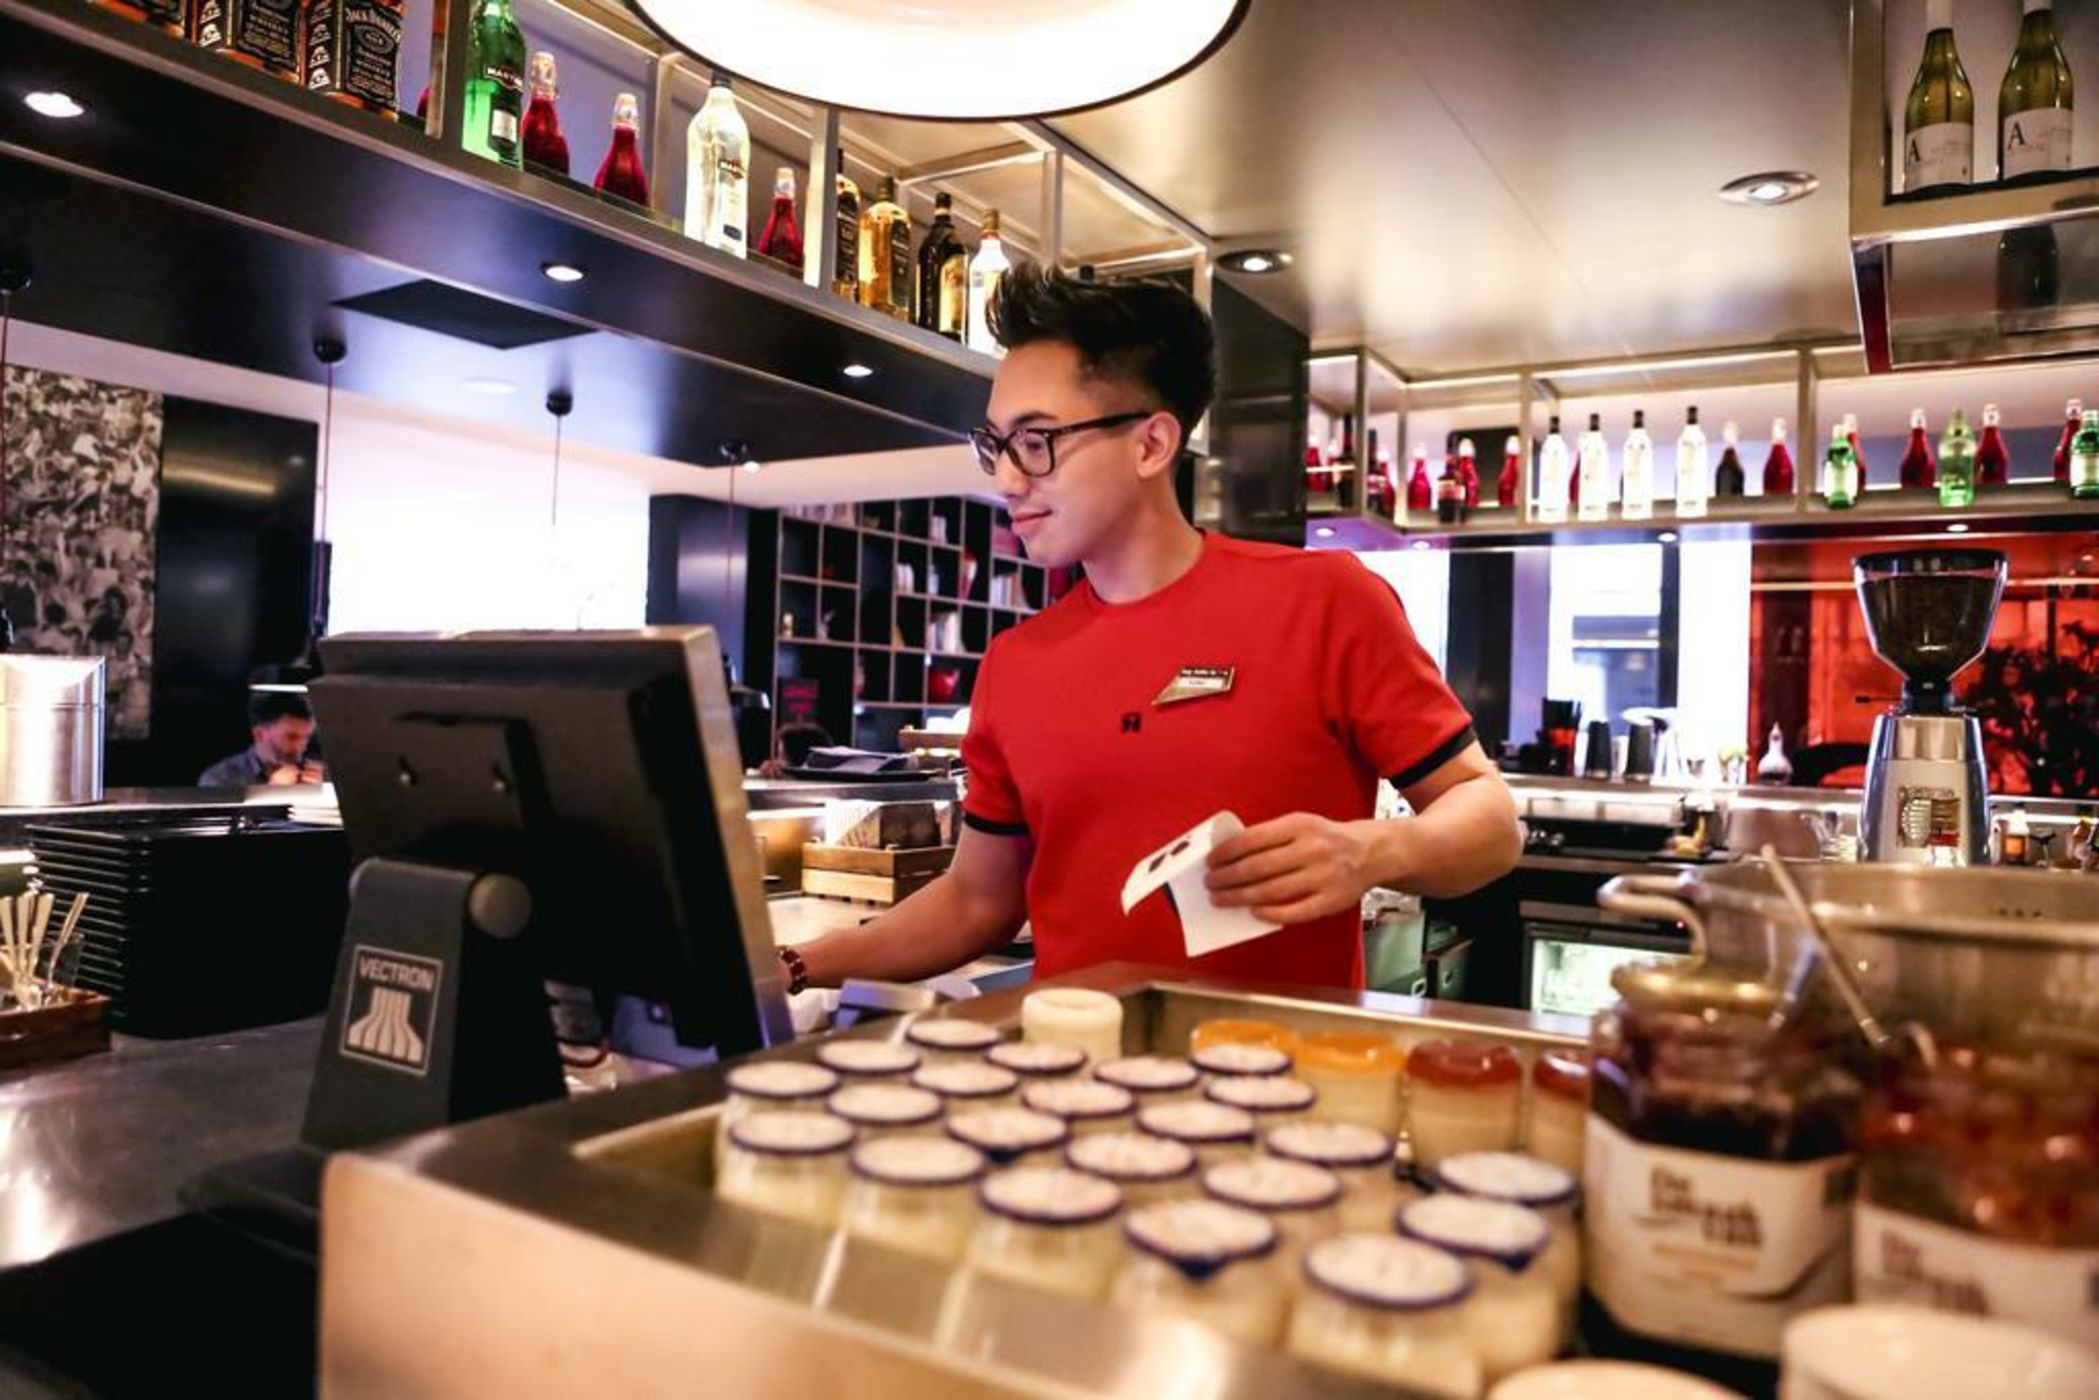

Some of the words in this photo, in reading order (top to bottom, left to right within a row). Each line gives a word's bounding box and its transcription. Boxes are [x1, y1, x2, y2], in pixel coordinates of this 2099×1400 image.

[2006, 121, 2026, 150] A
[1907, 137, 1921, 165] A
[359, 955, 435, 992] VECTRON
